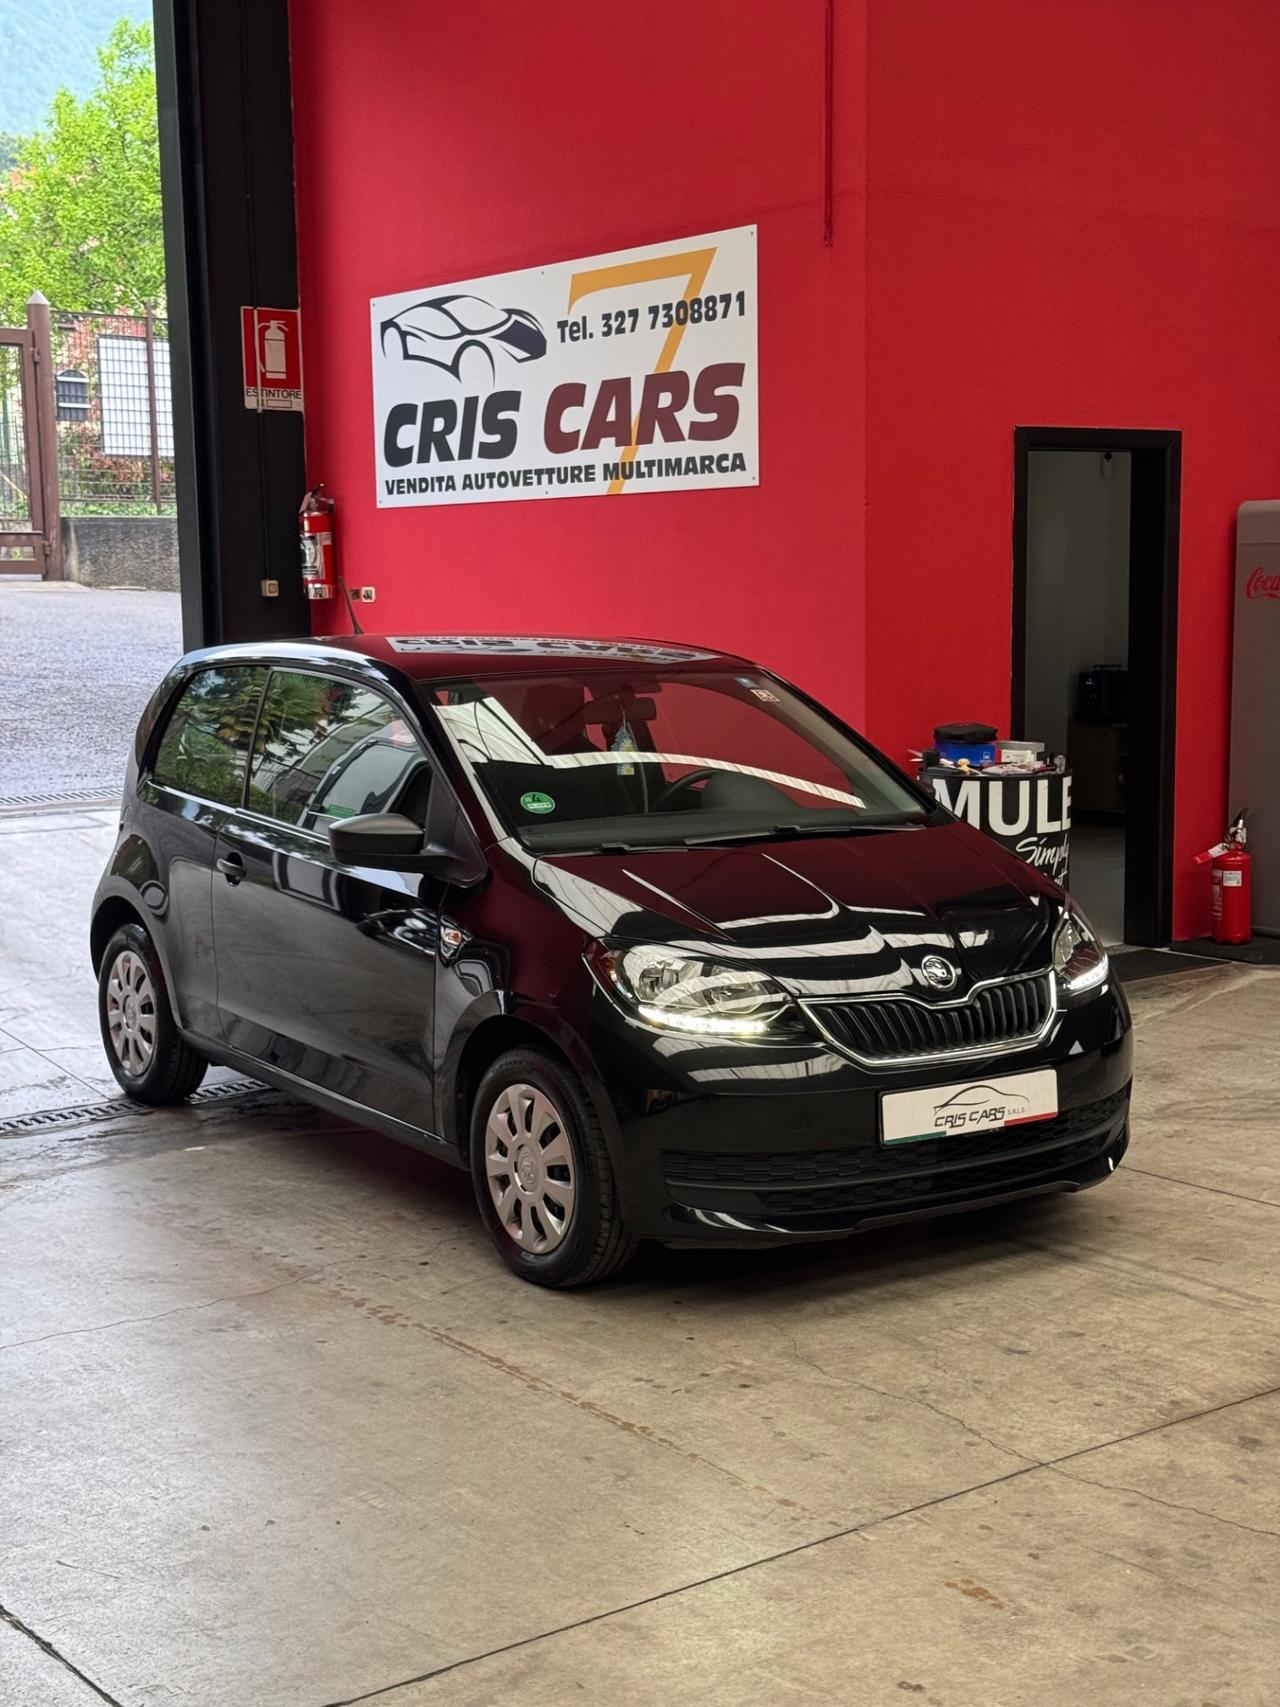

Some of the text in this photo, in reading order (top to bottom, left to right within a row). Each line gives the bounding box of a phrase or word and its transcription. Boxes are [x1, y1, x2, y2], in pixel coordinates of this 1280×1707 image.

[557, 291, 745, 343] Tel. 327 7308871
[246, 388, 303, 400] ESTINTORE
[383, 362, 746, 468] CRIS CARS
[385, 453, 747, 495] VENDITA AUTOVETTURE MULTIMARCA
[932, 776, 1072, 836] MULE
[934, 1112, 967, 1129] CRIS
[968, 1106, 1006, 1125] CARS
